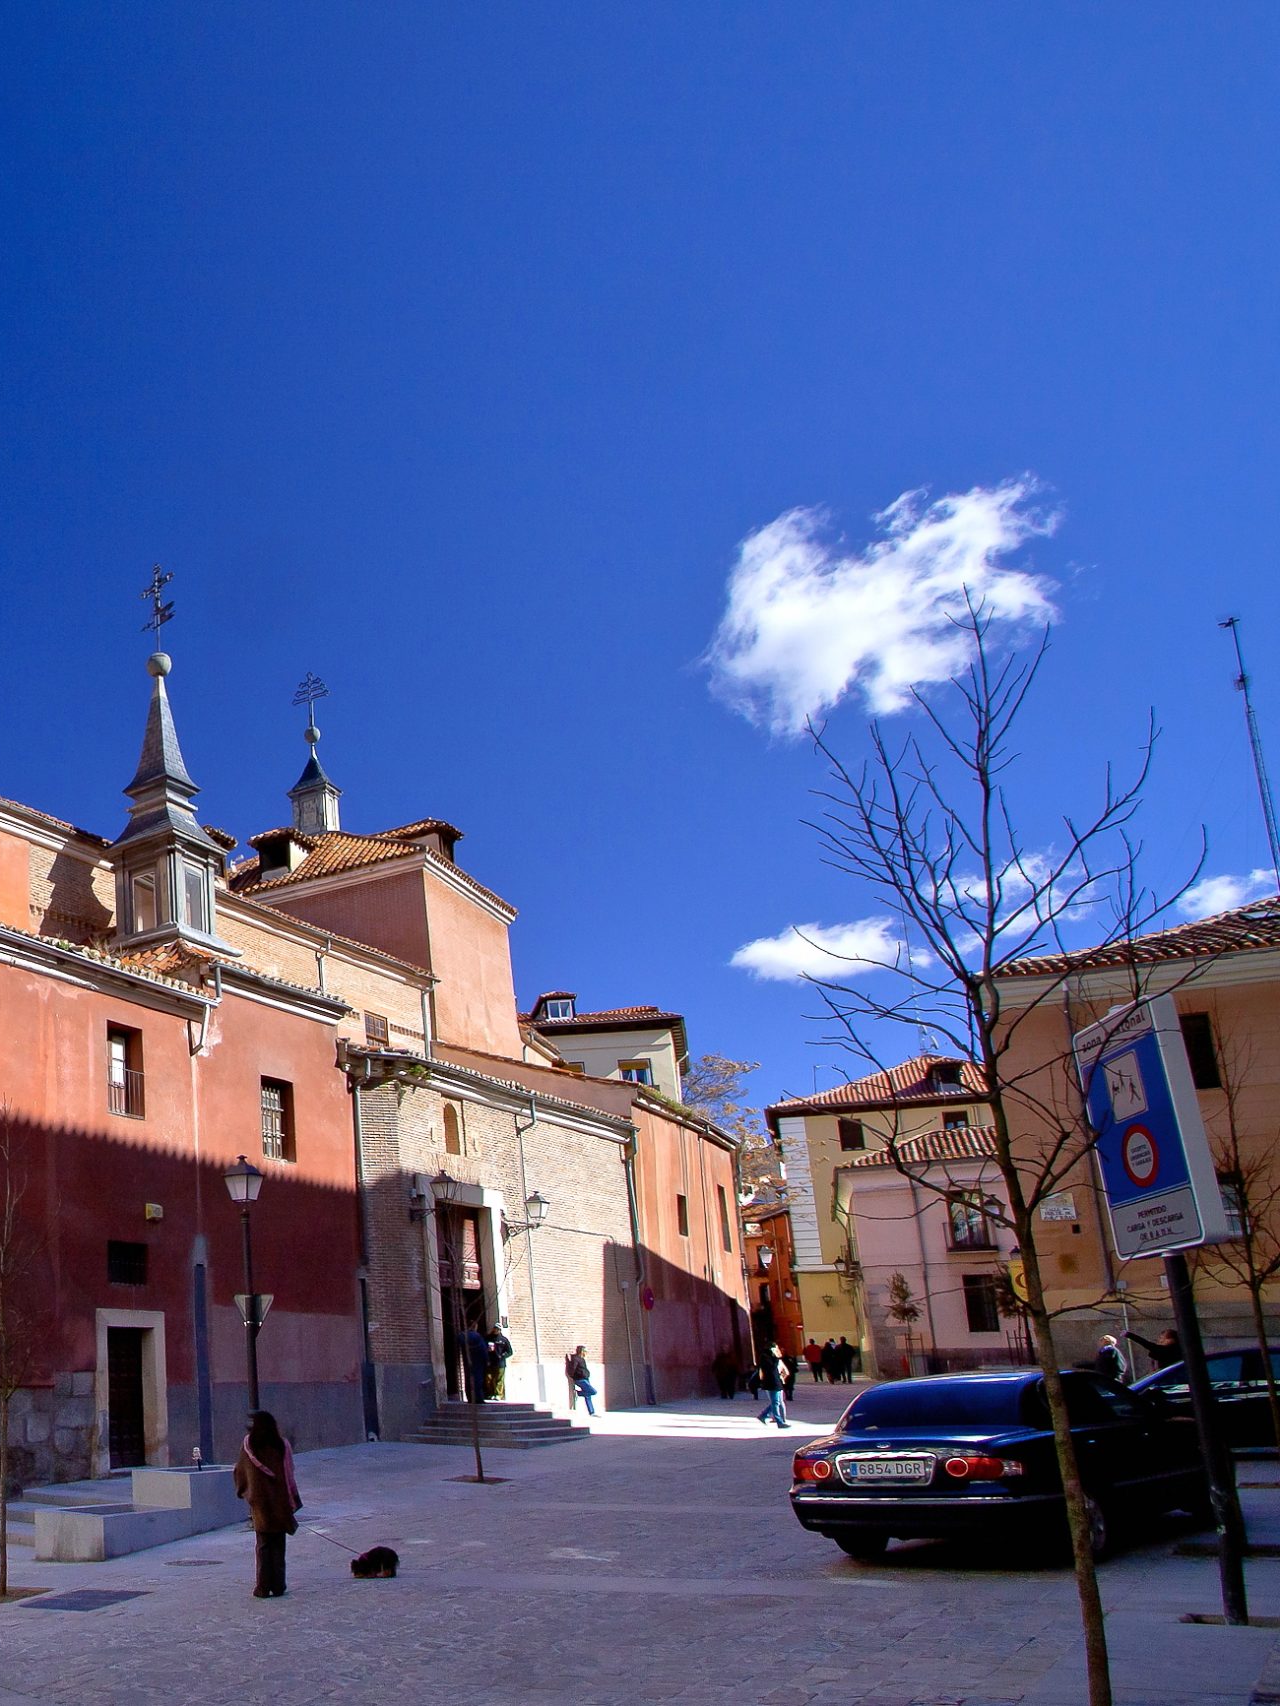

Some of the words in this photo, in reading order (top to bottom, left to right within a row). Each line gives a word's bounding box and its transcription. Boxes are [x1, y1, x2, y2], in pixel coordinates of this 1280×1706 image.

[1082, 1035, 1102, 1053] zona
[1137, 1204, 1167, 1219] PERMITIDO
[1126, 1222, 1145, 1233] CARGA
[1152, 1212, 1184, 1227] DESCARGA
[858, 1463, 892, 1475] 6854
[895, 1462, 921, 1475] DGR
